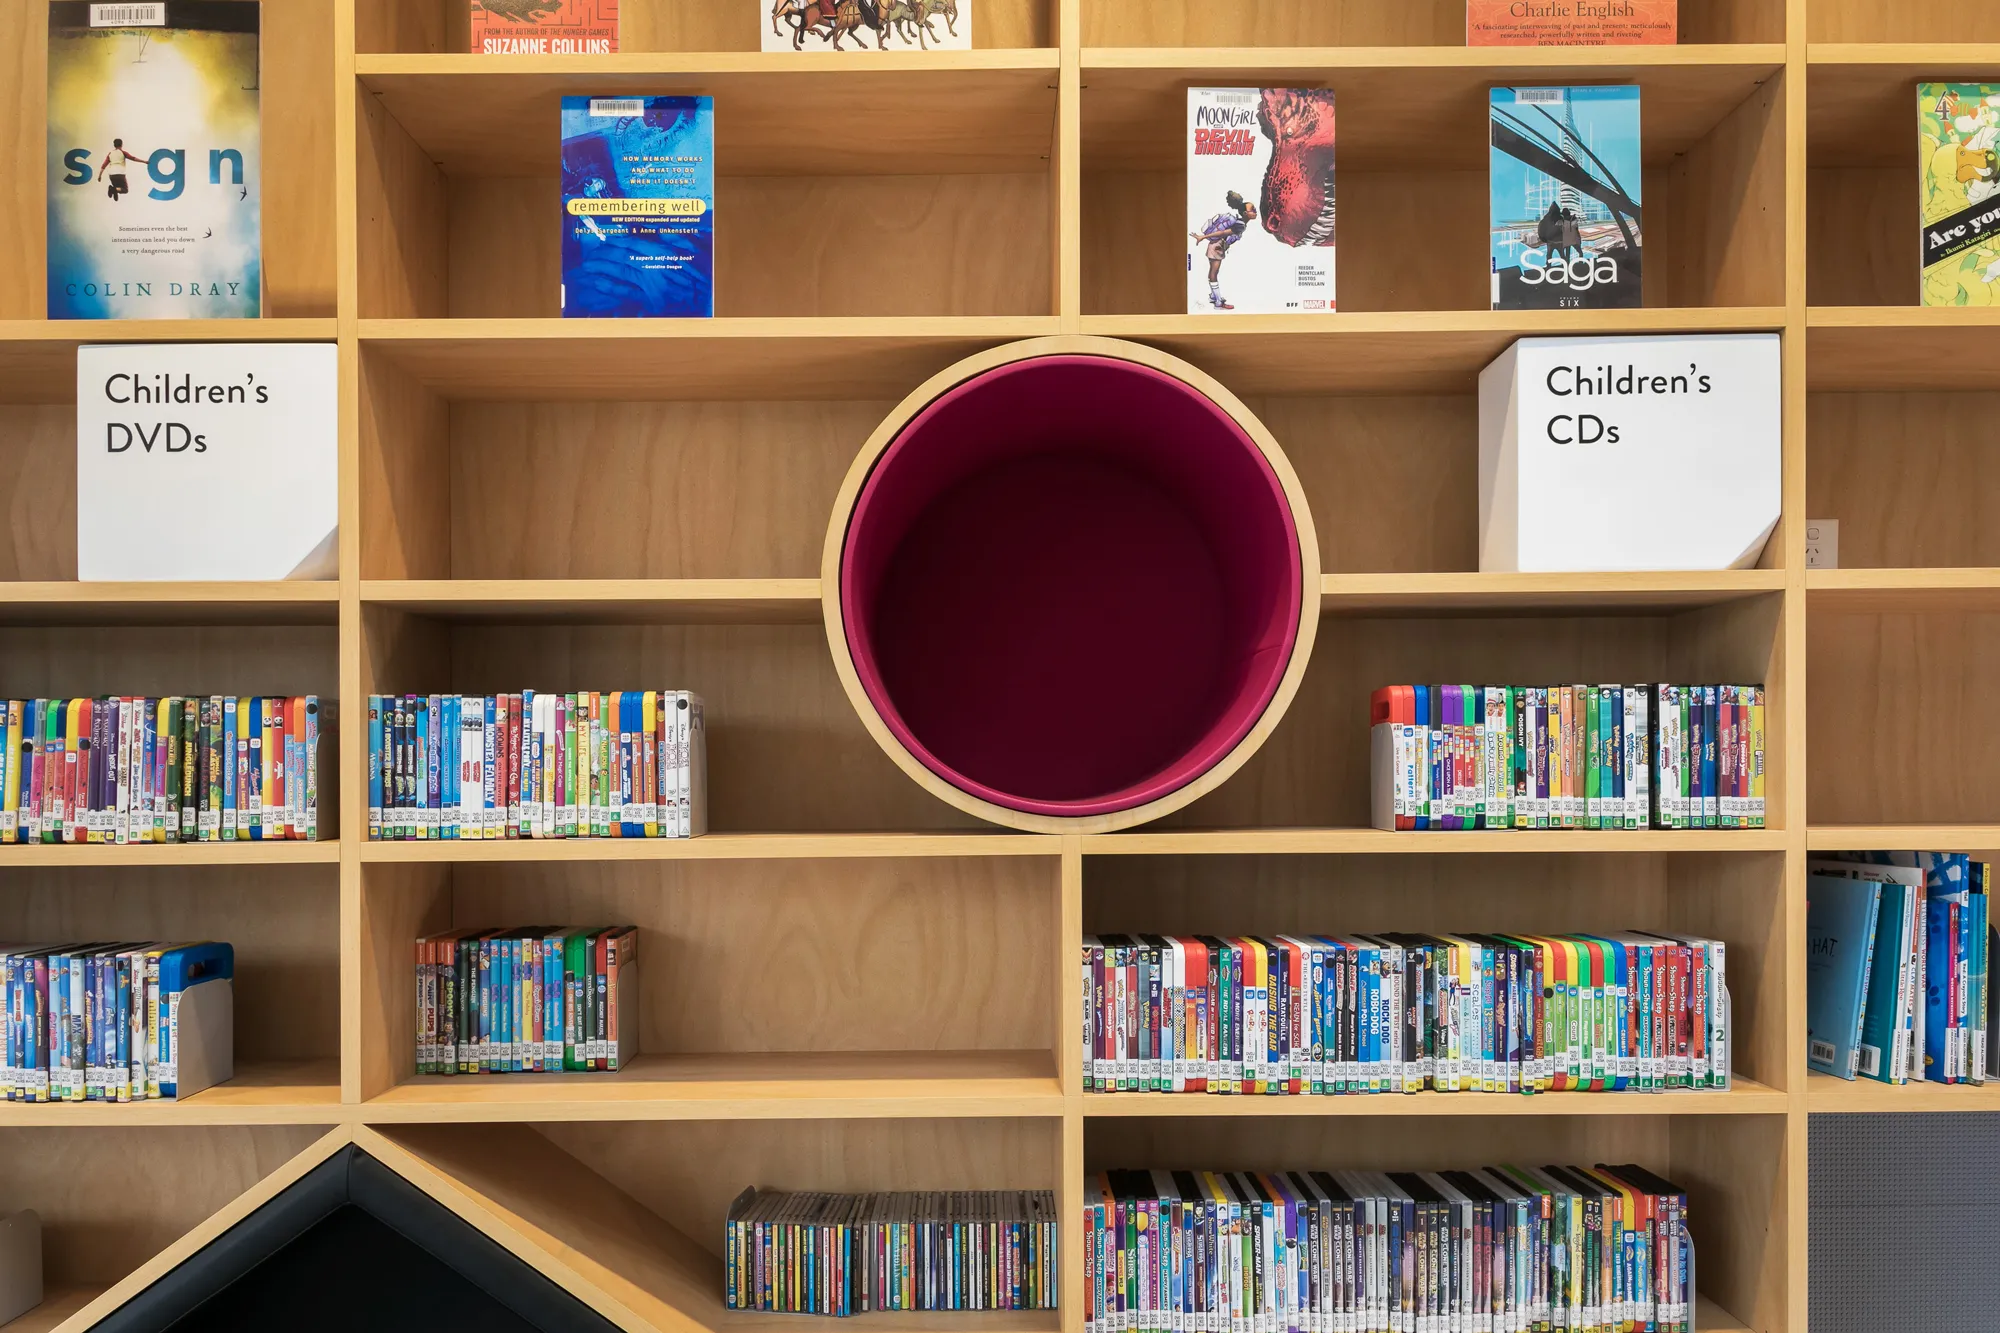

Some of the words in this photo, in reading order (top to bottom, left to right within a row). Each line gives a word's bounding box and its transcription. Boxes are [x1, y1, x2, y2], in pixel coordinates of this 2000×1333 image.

[1510, 0, 1570, 18] Charlie
[1577, 1, 1635, 20] English
[483, 38, 547, 54] SUZANNE
[551, 38, 610, 54] COLLINS
[1934, 91, 1950, 120] 4
[1194, 129, 1256, 142] DEVIL
[1194, 142, 1255, 156] DINOSAUR
[574, 200, 666, 214] remembering
[671, 200, 700, 212] well
[1929, 224, 1967, 250] Are
[140, 247, 171, 255] dangerous
[1519, 249, 1619, 290] Saga
[66, 282, 152, 296] COLIN
[169, 282, 241, 296] DRAY
[1303, 300, 1326, 309] MARVEL
[107, 422, 208, 453] DVDs
[1546, 414, 1620, 445] CDs
[446, 981, 454, 1018] SPOOKY
[1268, 973, 1277, 1012] RAISING
[1472, 983, 1481, 1021] scales
[1370, 988, 1379, 1035] ROBO-DOG
[1381, 999, 1390, 1023] ROCK
[1268, 1014, 1277, 1031] THE
[1268, 1031, 1277, 1051] BAR
[1381, 1026, 1390, 1045] DOG
[1716, 1030, 1724, 1041] 2
[1254, 1225, 1262, 1275] SPIDER-MAN
